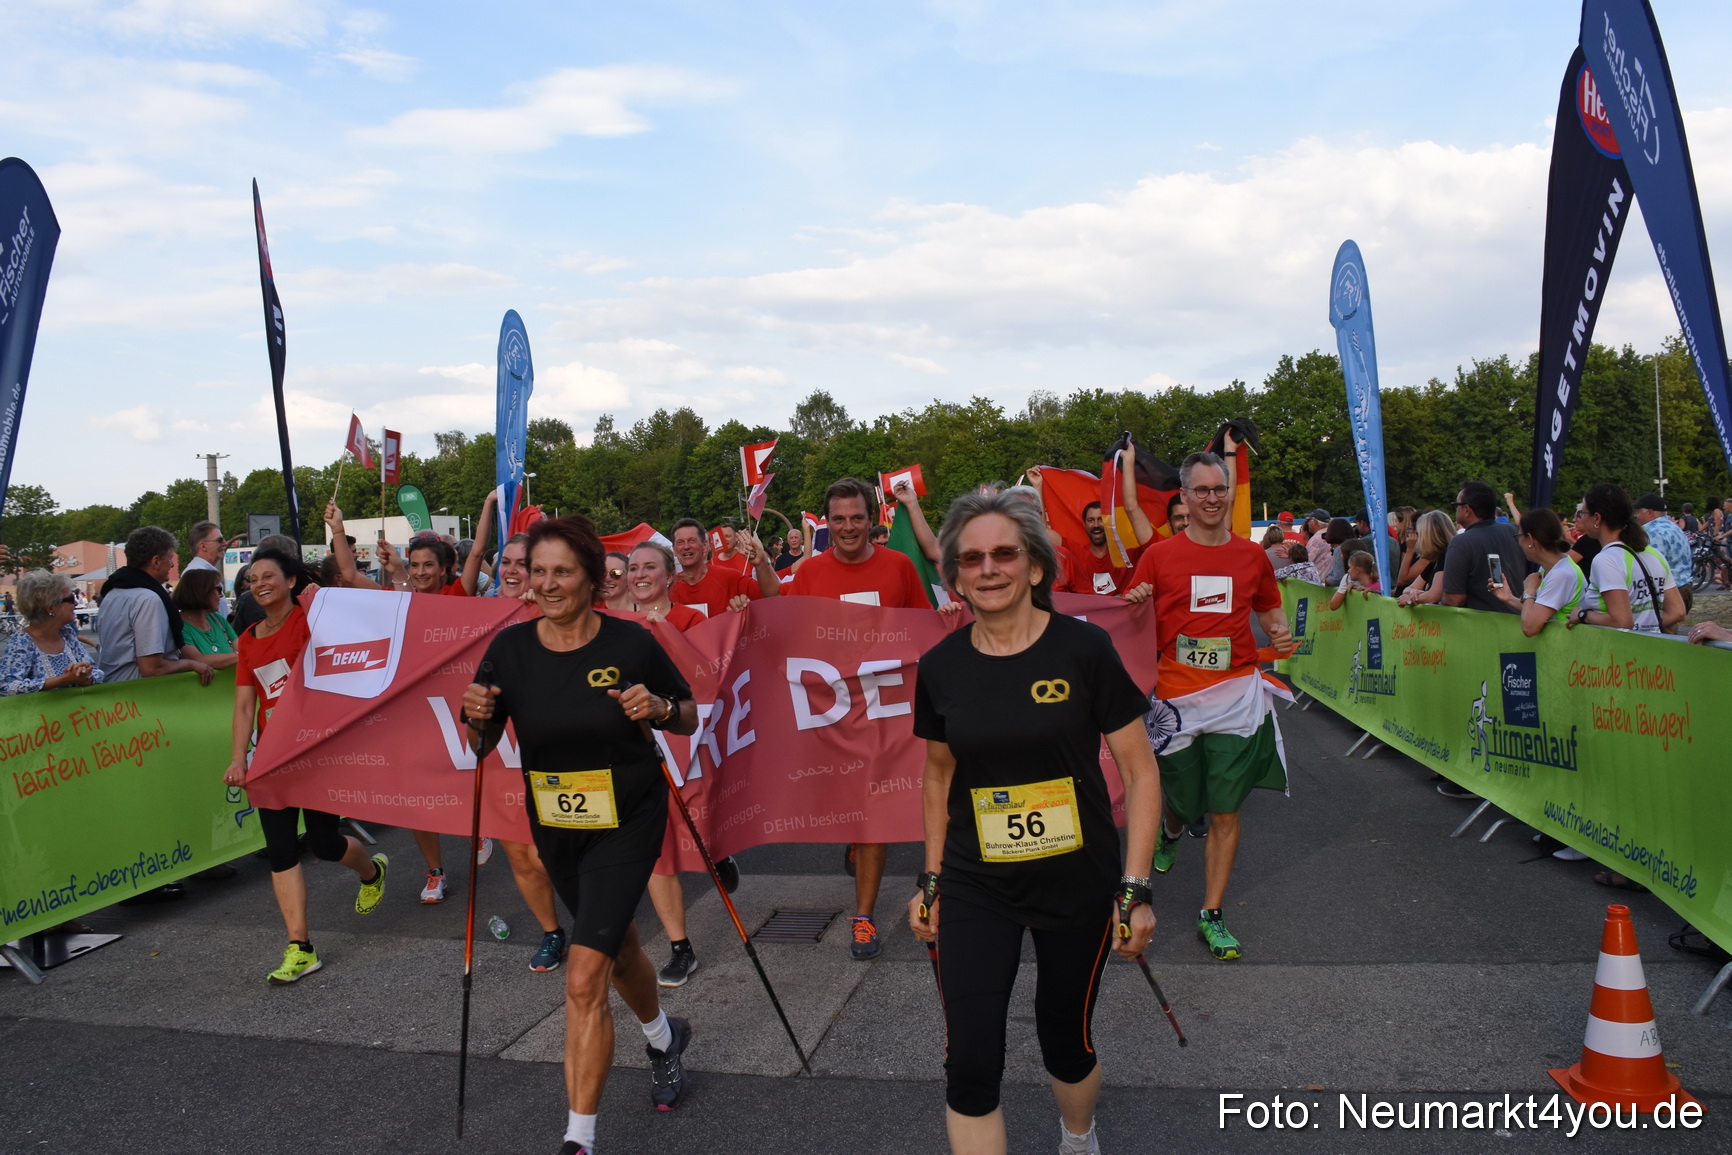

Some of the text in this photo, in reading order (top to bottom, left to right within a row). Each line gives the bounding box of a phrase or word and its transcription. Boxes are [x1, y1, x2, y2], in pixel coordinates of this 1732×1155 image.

[1584, 70, 1611, 124] He
[10, 226, 35, 307] AUTOMOBILE
[424, 625, 459, 643] DEHN
[816, 626, 912, 643] DEHN chroni.
[332, 650, 371, 667] DEHN
[1187, 651, 1218, 665] 478
[695, 664, 706, 679] A
[1568, 653, 1675, 692] Gesunde Firmen
[1507, 675, 1531, 689] Fischer
[69, 701, 142, 737] Firmen
[1592, 695, 1692, 752] laufen länger!
[1491, 716, 1577, 771] firmenlauf
[13, 718, 171, 798] laufen länger!
[317, 752, 390, 766] chireletsa.
[1494, 761, 1531, 778] neumarkt
[869, 777, 913, 796] DEHN
[328, 789, 463, 810] DEHN inochengeta.
[557, 793, 588, 813] 62
[763, 809, 868, 834] DEHN beskerm.
[1007, 811, 1046, 841] 56
[985, 833, 1076, 850] Buhrow-Klaus Christine
[1041, 843, 1058, 851] GmbH
[1544, 800, 1697, 898] www.firmenlauf-oberpfalz.de
[1121, 887, 1134, 911] LEKI
